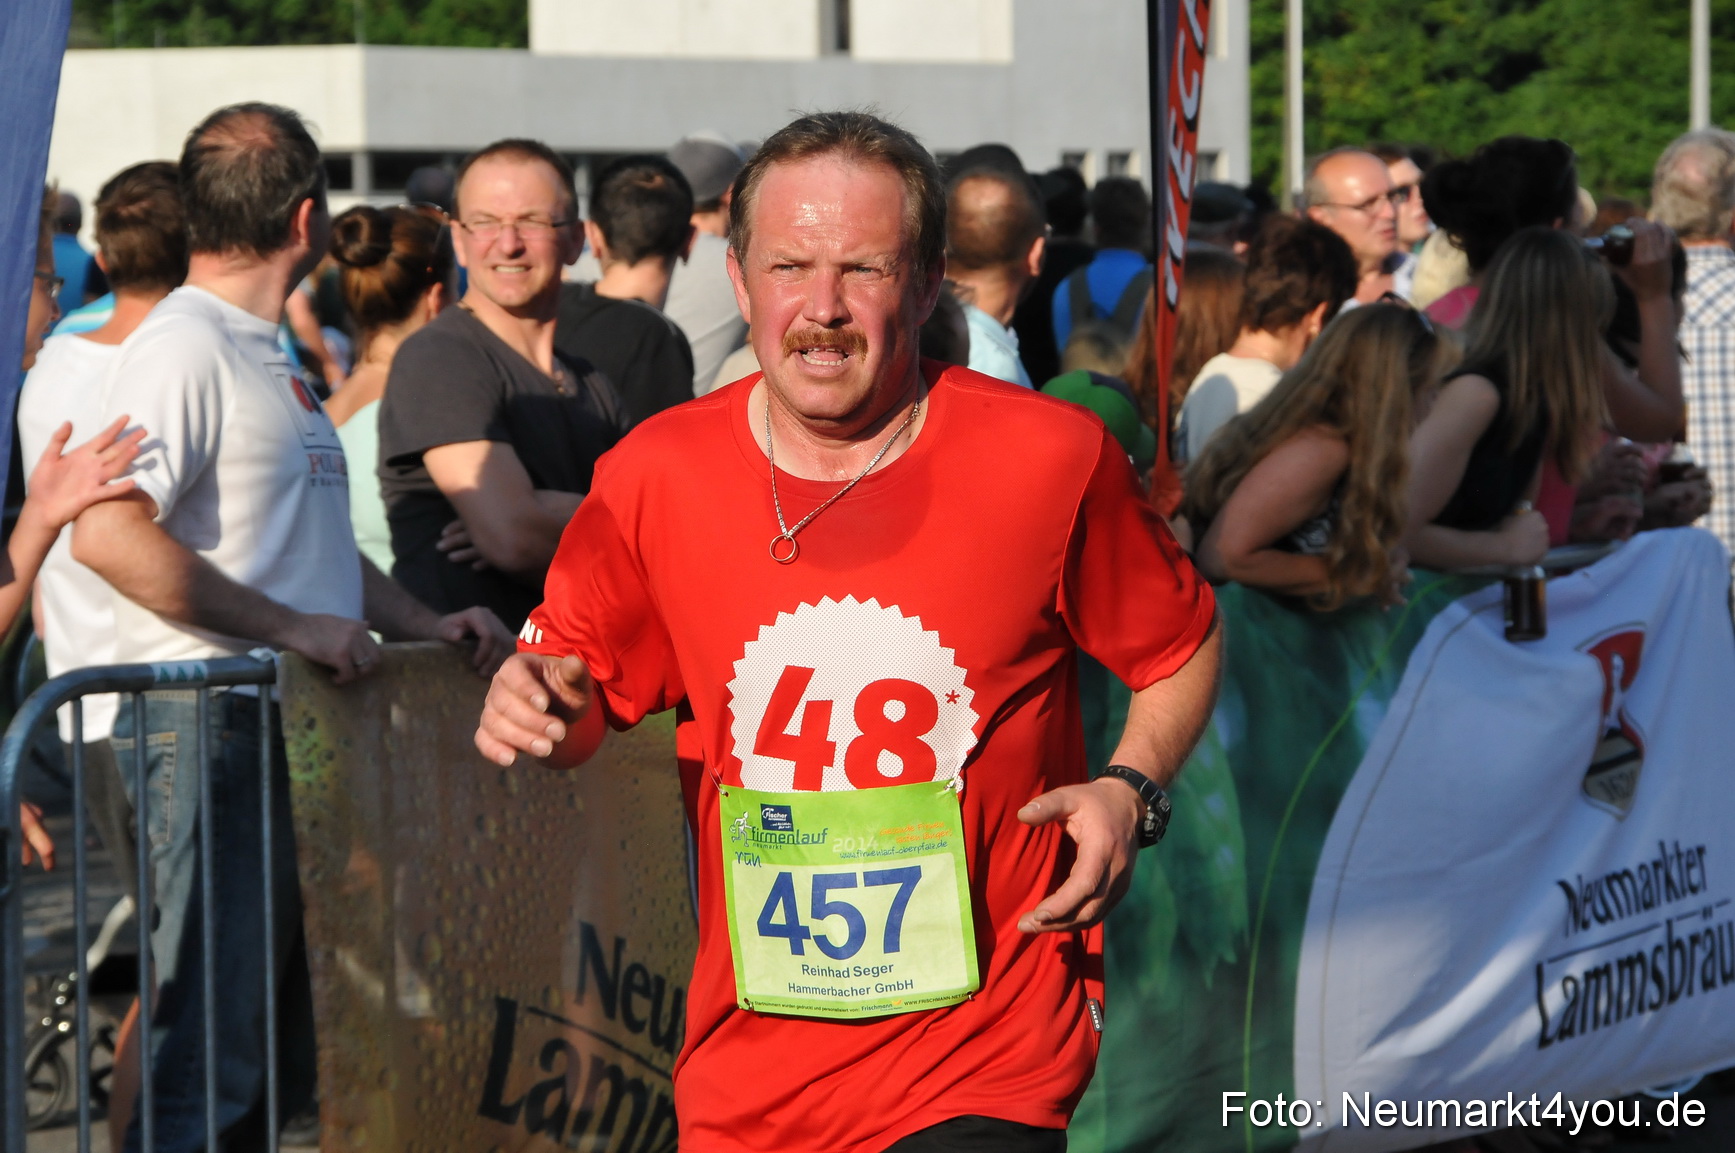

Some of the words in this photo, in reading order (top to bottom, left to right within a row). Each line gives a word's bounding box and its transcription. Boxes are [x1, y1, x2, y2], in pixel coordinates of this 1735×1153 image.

[751, 827, 829, 846] firmenlauf
[832, 836, 879, 853] 2014
[1557, 839, 1707, 938] Neumarkter
[757, 865, 922, 961] 457
[801, 963, 850, 979] Reinhad
[853, 962, 894, 978] Seger
[788, 982, 871, 997] Hammerbacher
[875, 979, 914, 994] GmbH
